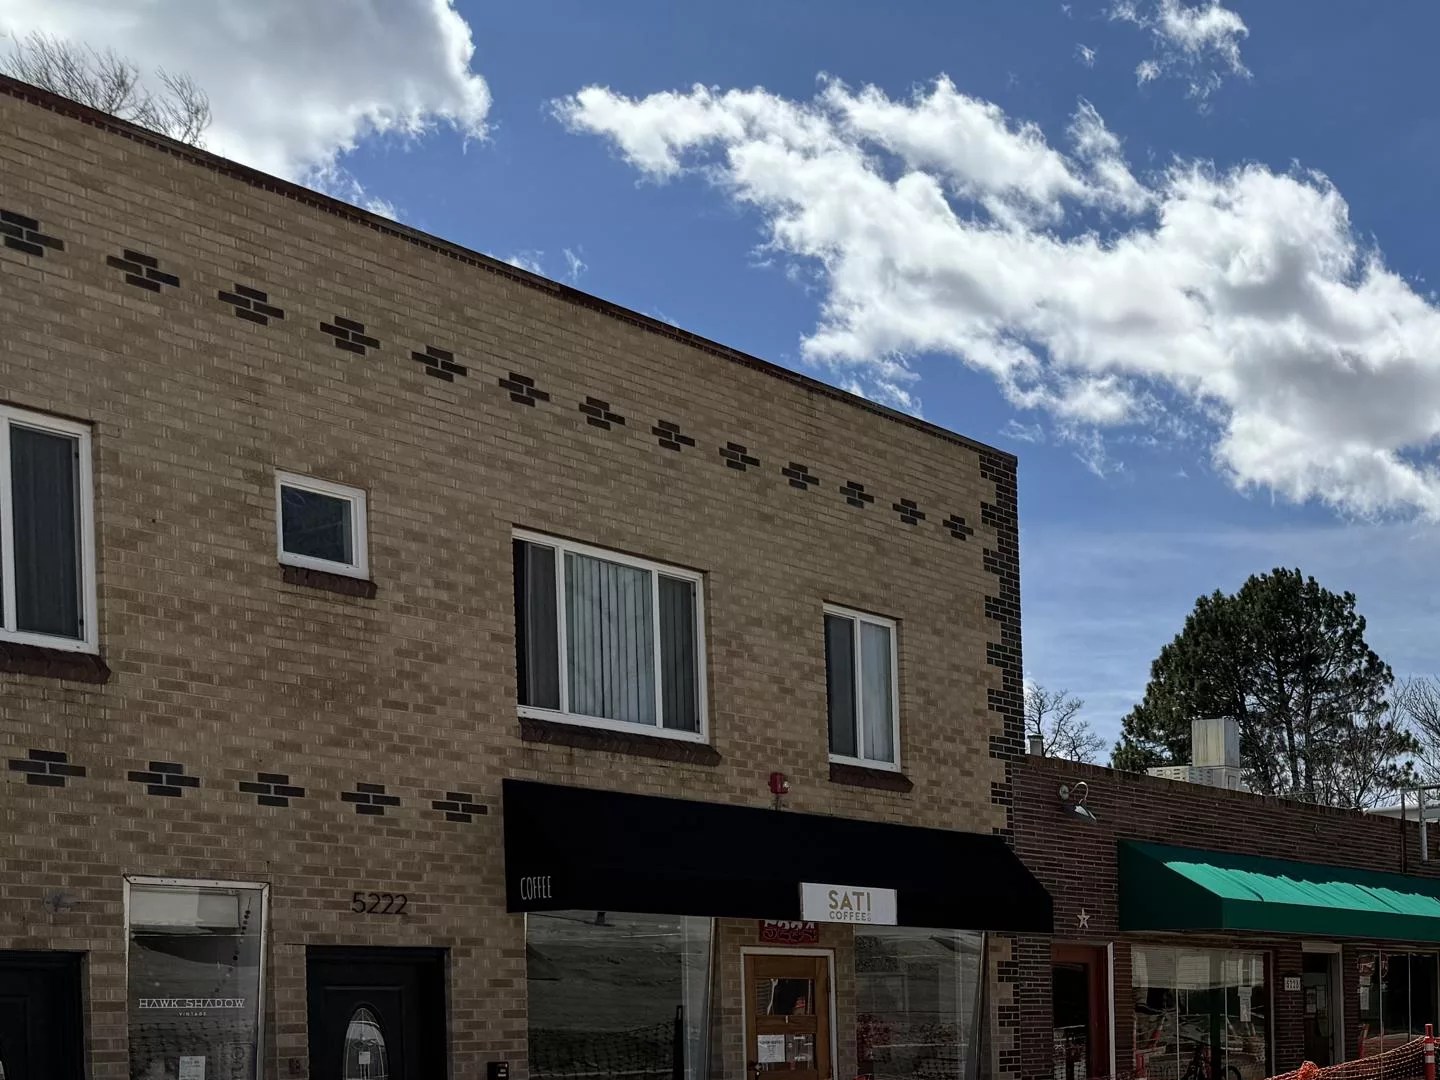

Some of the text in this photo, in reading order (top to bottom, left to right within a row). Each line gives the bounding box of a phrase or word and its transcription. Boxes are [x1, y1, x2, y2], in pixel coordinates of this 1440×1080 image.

[520, 876, 552, 900] COFFEE
[352, 892, 408, 915] 5222
[828, 889, 871, 911] SATI
[829, 911, 867, 921] COFFEE
[139, 998, 245, 1009] HAWK SHADOW
